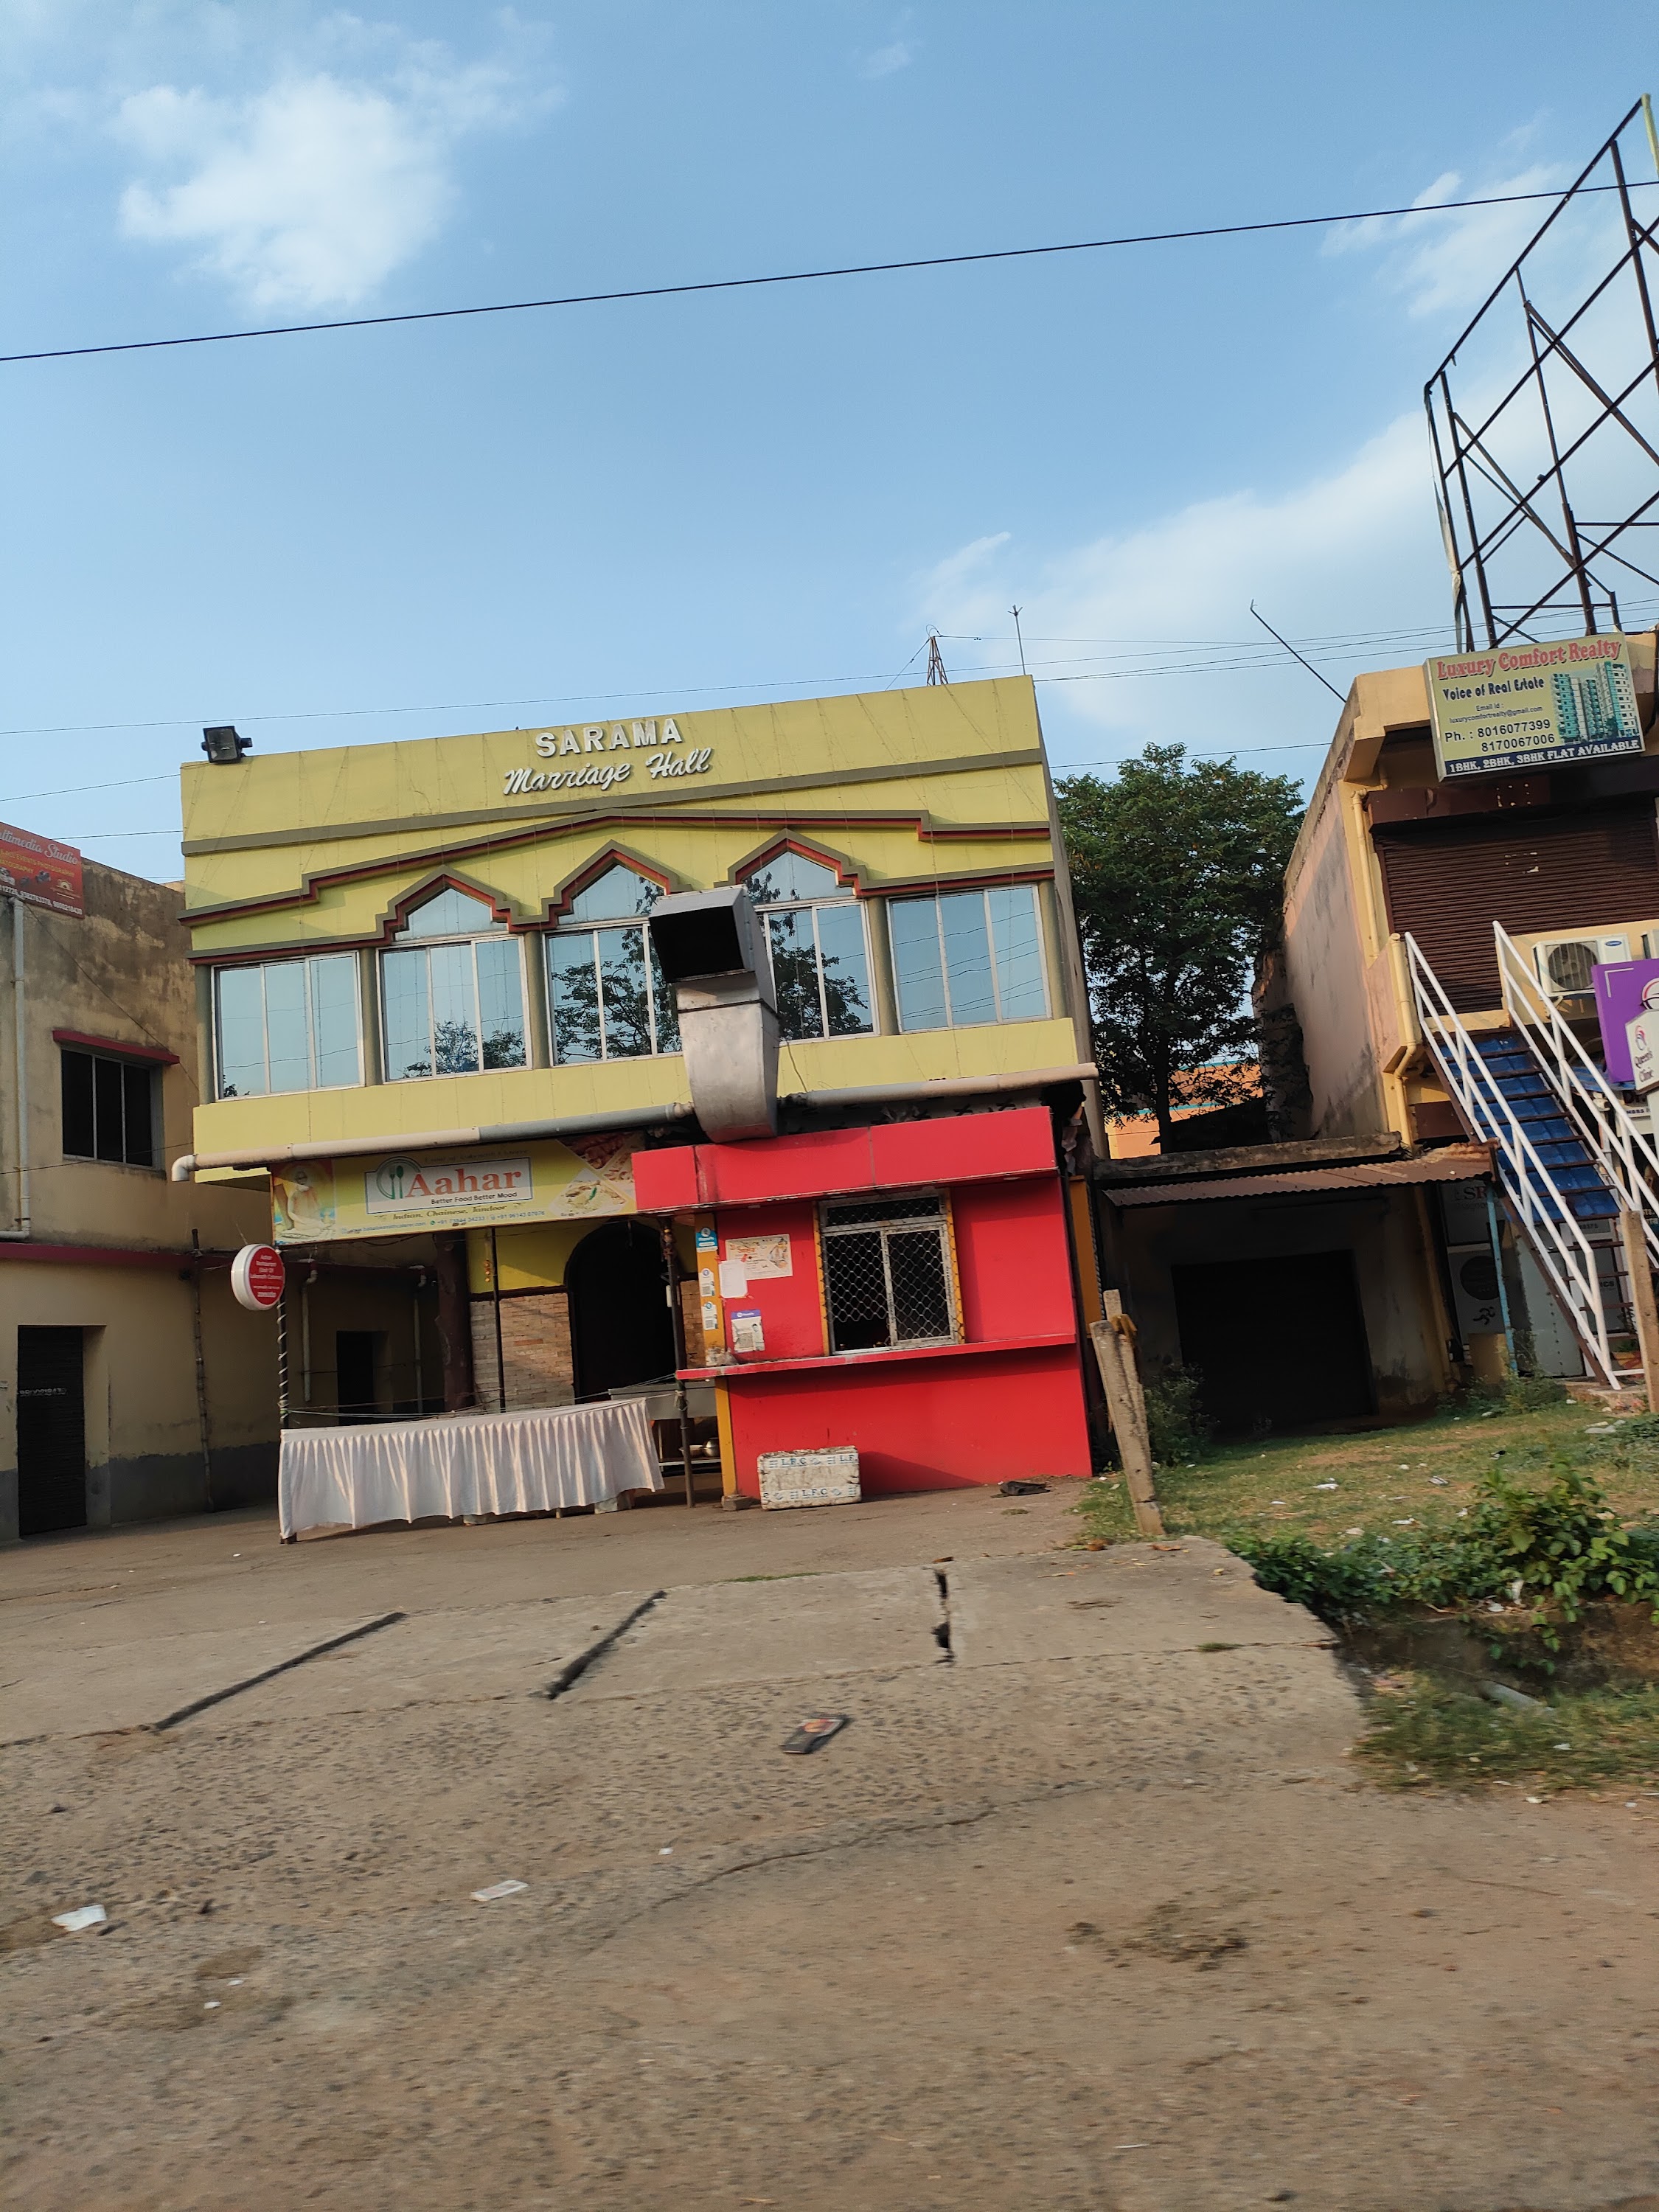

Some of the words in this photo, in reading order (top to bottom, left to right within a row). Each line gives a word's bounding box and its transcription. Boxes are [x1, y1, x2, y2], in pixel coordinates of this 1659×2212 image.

[1436, 657, 1495, 680] Luxury
[1498, 647, 1567, 671] Comfort
[1568, 639, 1622, 661] Realty
[1442, 686, 1472, 700] Voice
[1475, 684, 1485, 697] of
[1488, 680, 1512, 695] Real
[1514, 676, 1545, 692] Estate
[1449, 706, 1543, 723] luxurycomfortrealty@gmail.com
[1475, 704, 1493, 712] Email
[535, 718, 683, 757] SARAMA
[1444, 731, 1466, 742] Ph.
[1477, 719, 1551, 737] 8016077399
[1481, 733, 1555, 752] 8170067006
[1449, 760, 1481, 773] 1BHK,
[1482, 756, 1514, 770] 2BHK,
[1516, 751, 1545, 764] 3BHK
[1547, 748, 1576, 759] FLAT
[1576, 740, 1641, 757] AVAILABLE
[503, 762, 632, 795] Marriage
[645, 746, 712, 779] Hall
[44, 844, 79, 865] Studio
[405, 1169, 522, 1198] Aahar
[431, 1196, 453, 1205] Better
[454, 1194, 473, 1203] Food
[473, 1192, 495, 1201] Better
[497, 1191, 518, 1199] Mood
[472, 1203, 508, 1214] Tandoor
